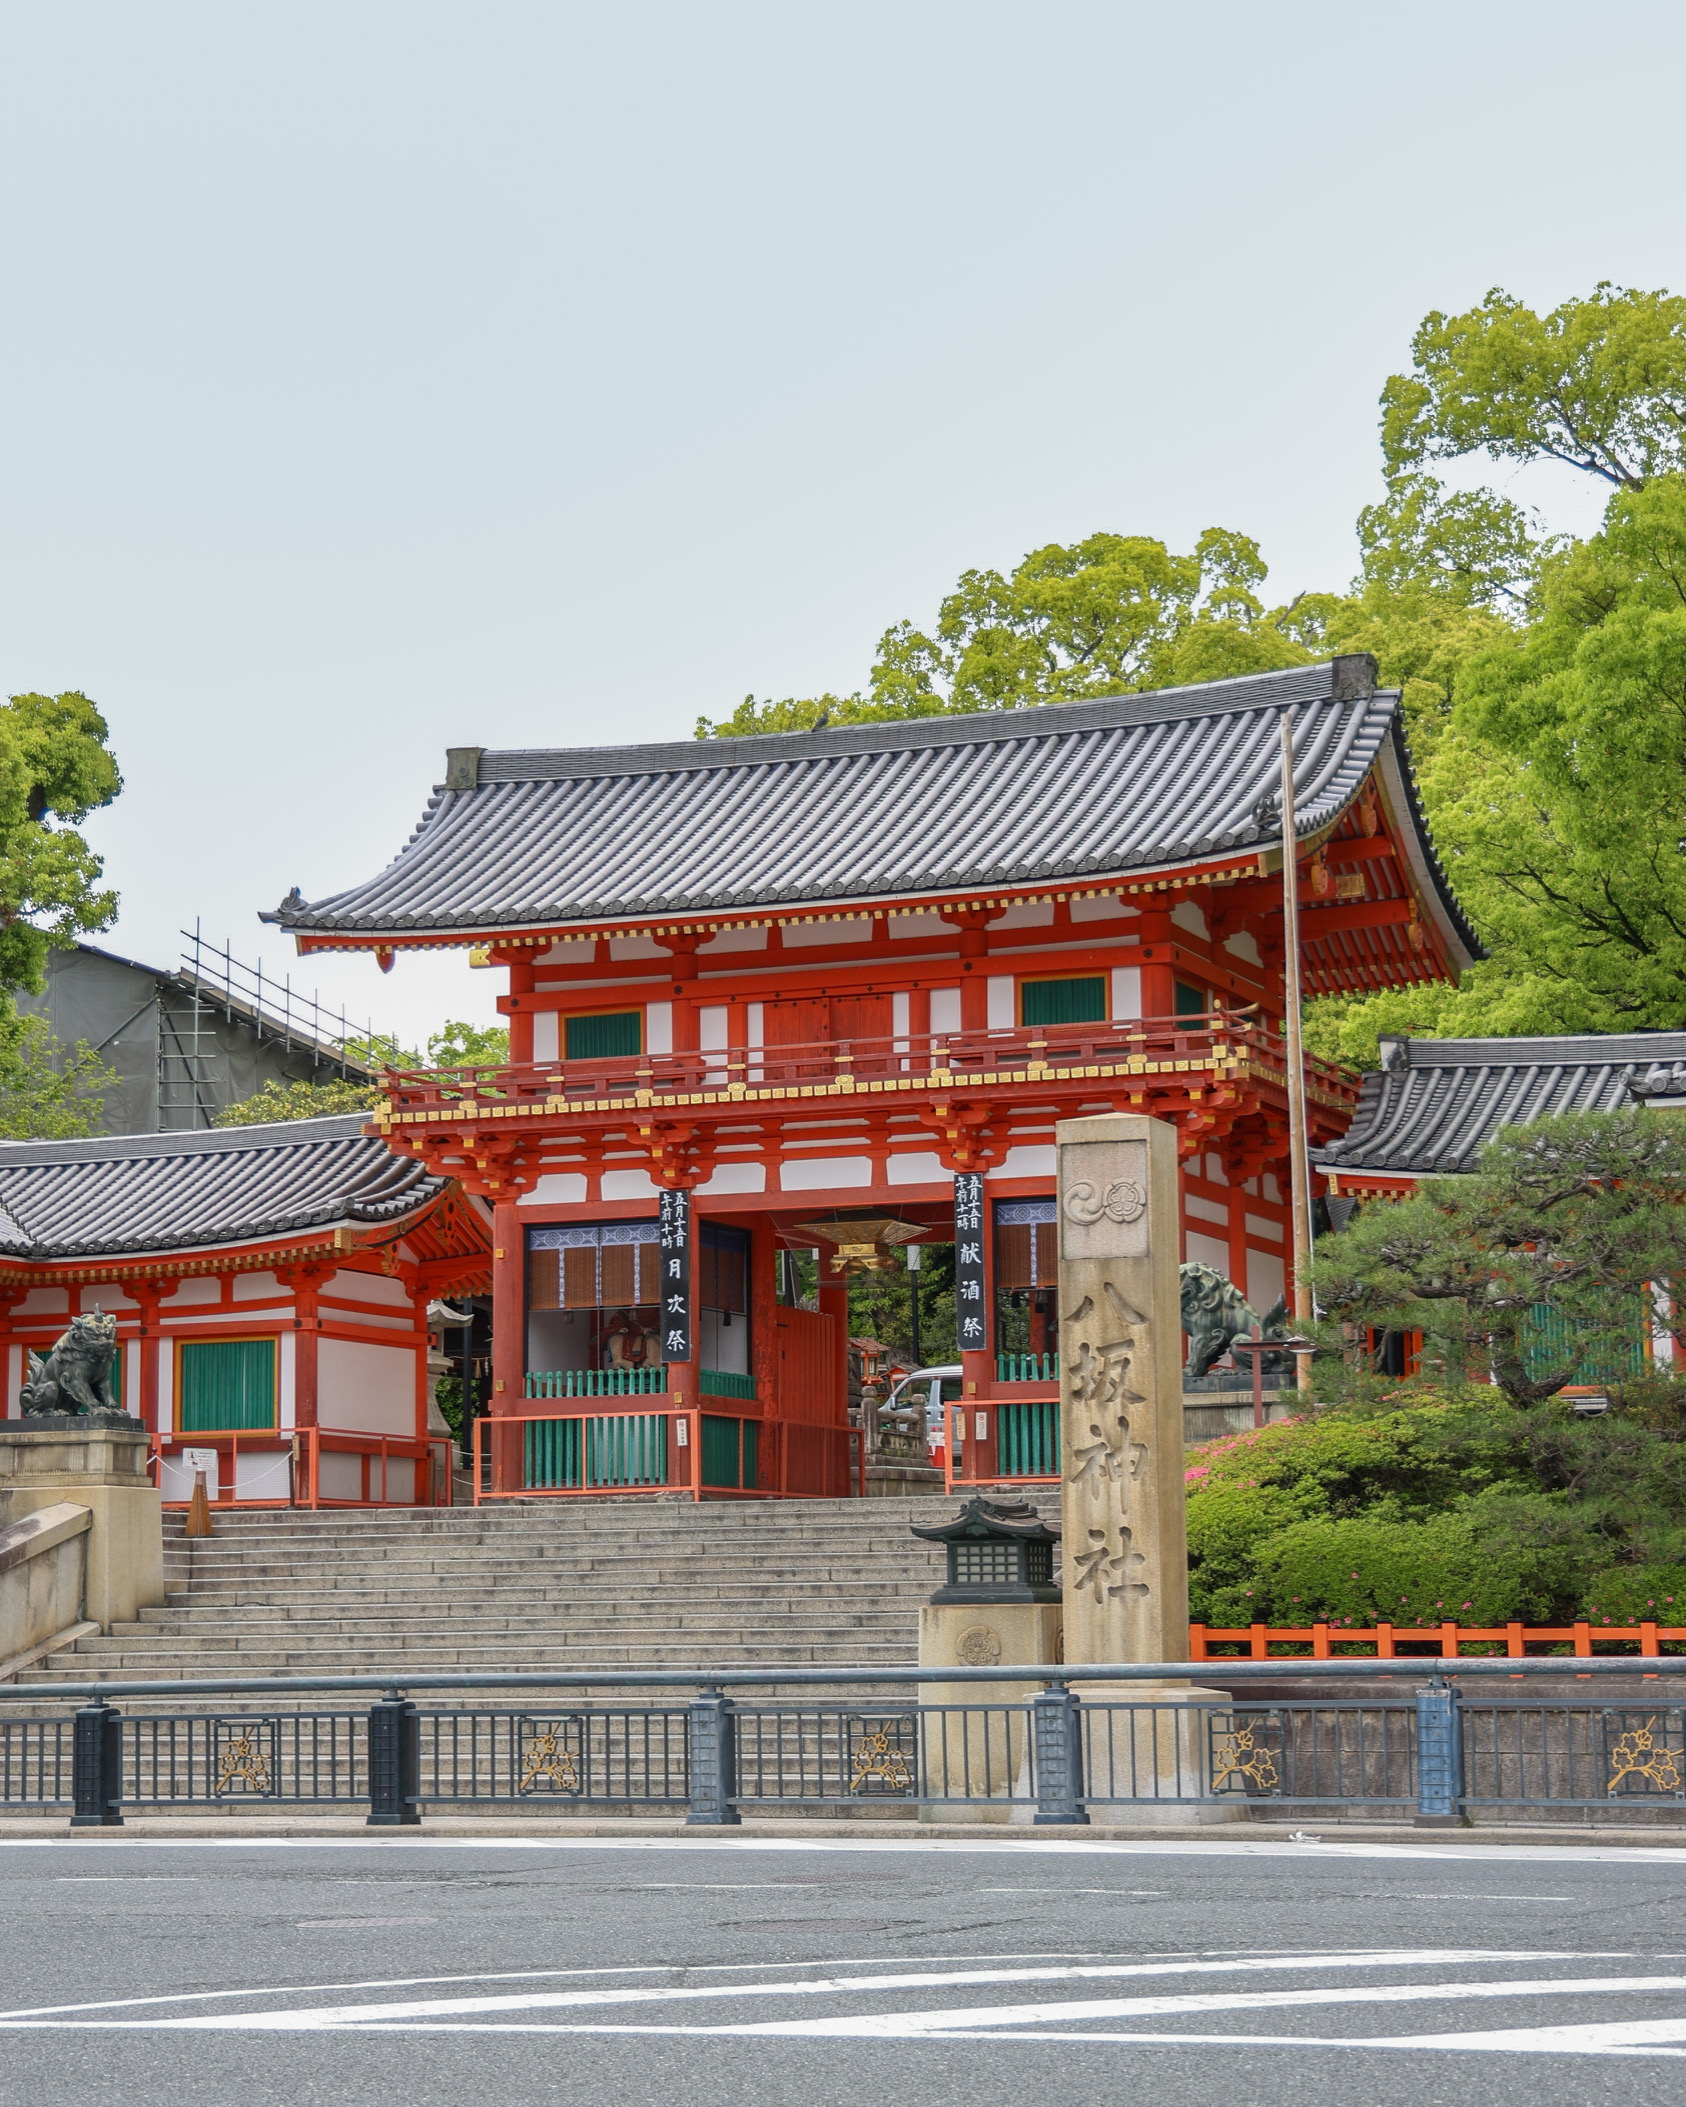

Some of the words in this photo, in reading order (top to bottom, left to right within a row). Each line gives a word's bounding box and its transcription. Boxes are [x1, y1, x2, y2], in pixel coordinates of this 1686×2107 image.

[661, 1193, 674, 1249] 午前十時
[673, 1192, 688, 1247] 五月十五日
[955, 1176, 969, 1230] 午前十一時
[967, 1175, 983, 1229] 五月十五日
[666, 1258, 687, 1352] 月次祭
[960, 1242, 982, 1338] 献酒祭
[1064, 1281, 1150, 1604] 八坂神社
